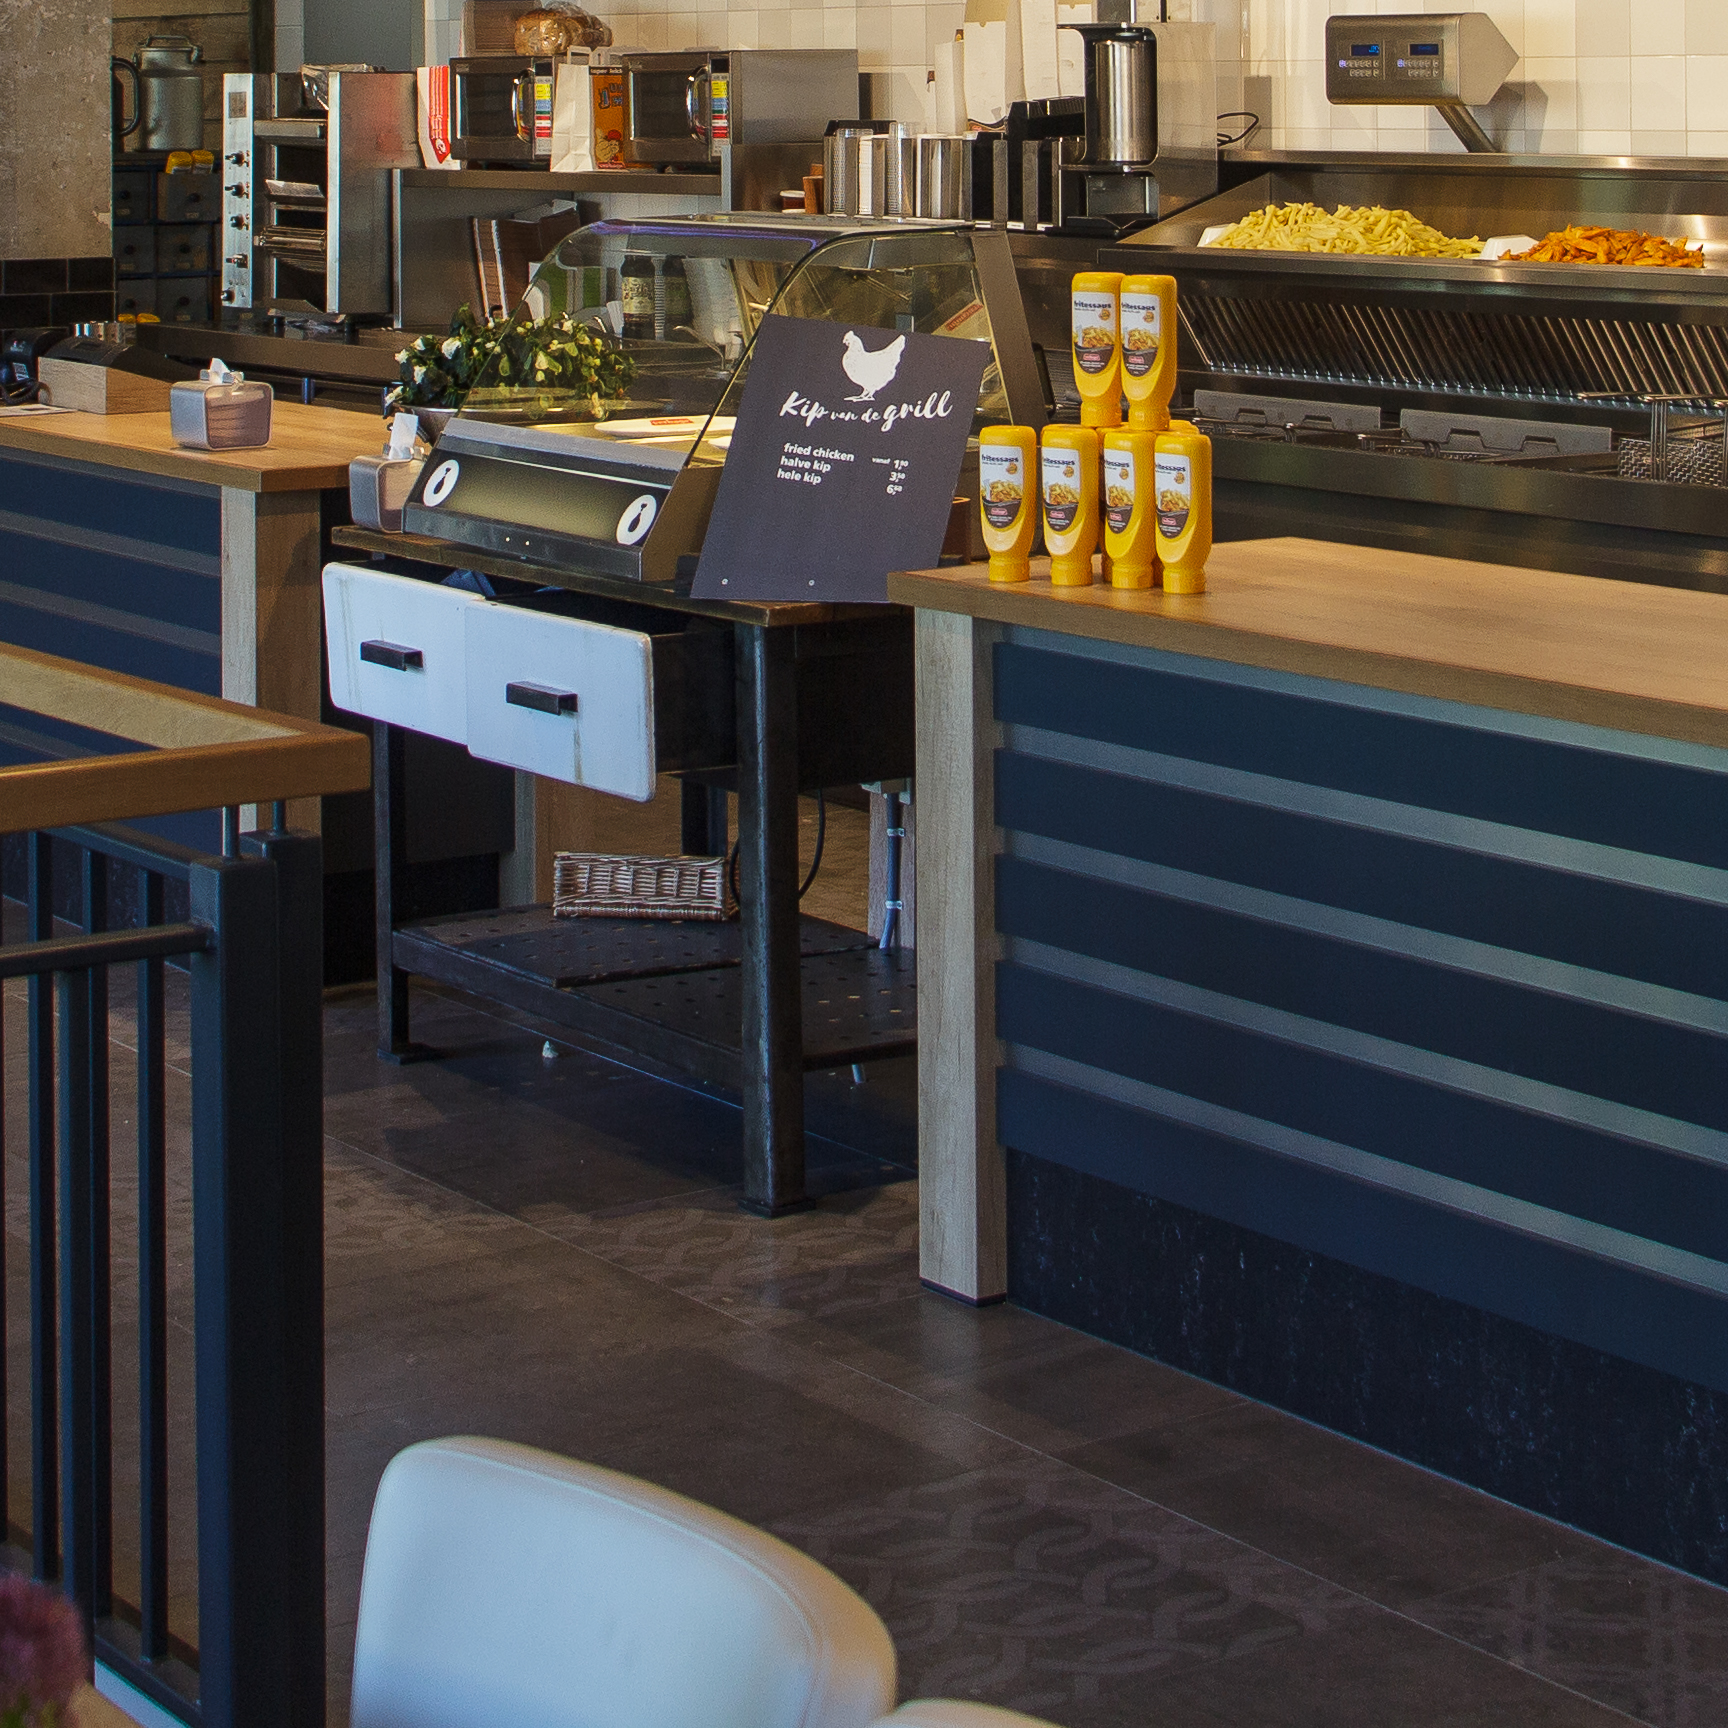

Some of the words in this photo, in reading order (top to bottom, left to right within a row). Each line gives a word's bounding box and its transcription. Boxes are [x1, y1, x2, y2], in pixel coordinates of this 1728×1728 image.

[779, 391, 829, 427] Kip
[861, 408, 881, 423] de
[881, 390, 953, 432] grill
[784, 442, 812, 456] fried
[813, 447, 855, 462] chicken
[780, 455, 811, 469] halve
[813, 459, 831, 473] kip
[777, 468, 802, 481] hele
[803, 471, 822, 485] kip
